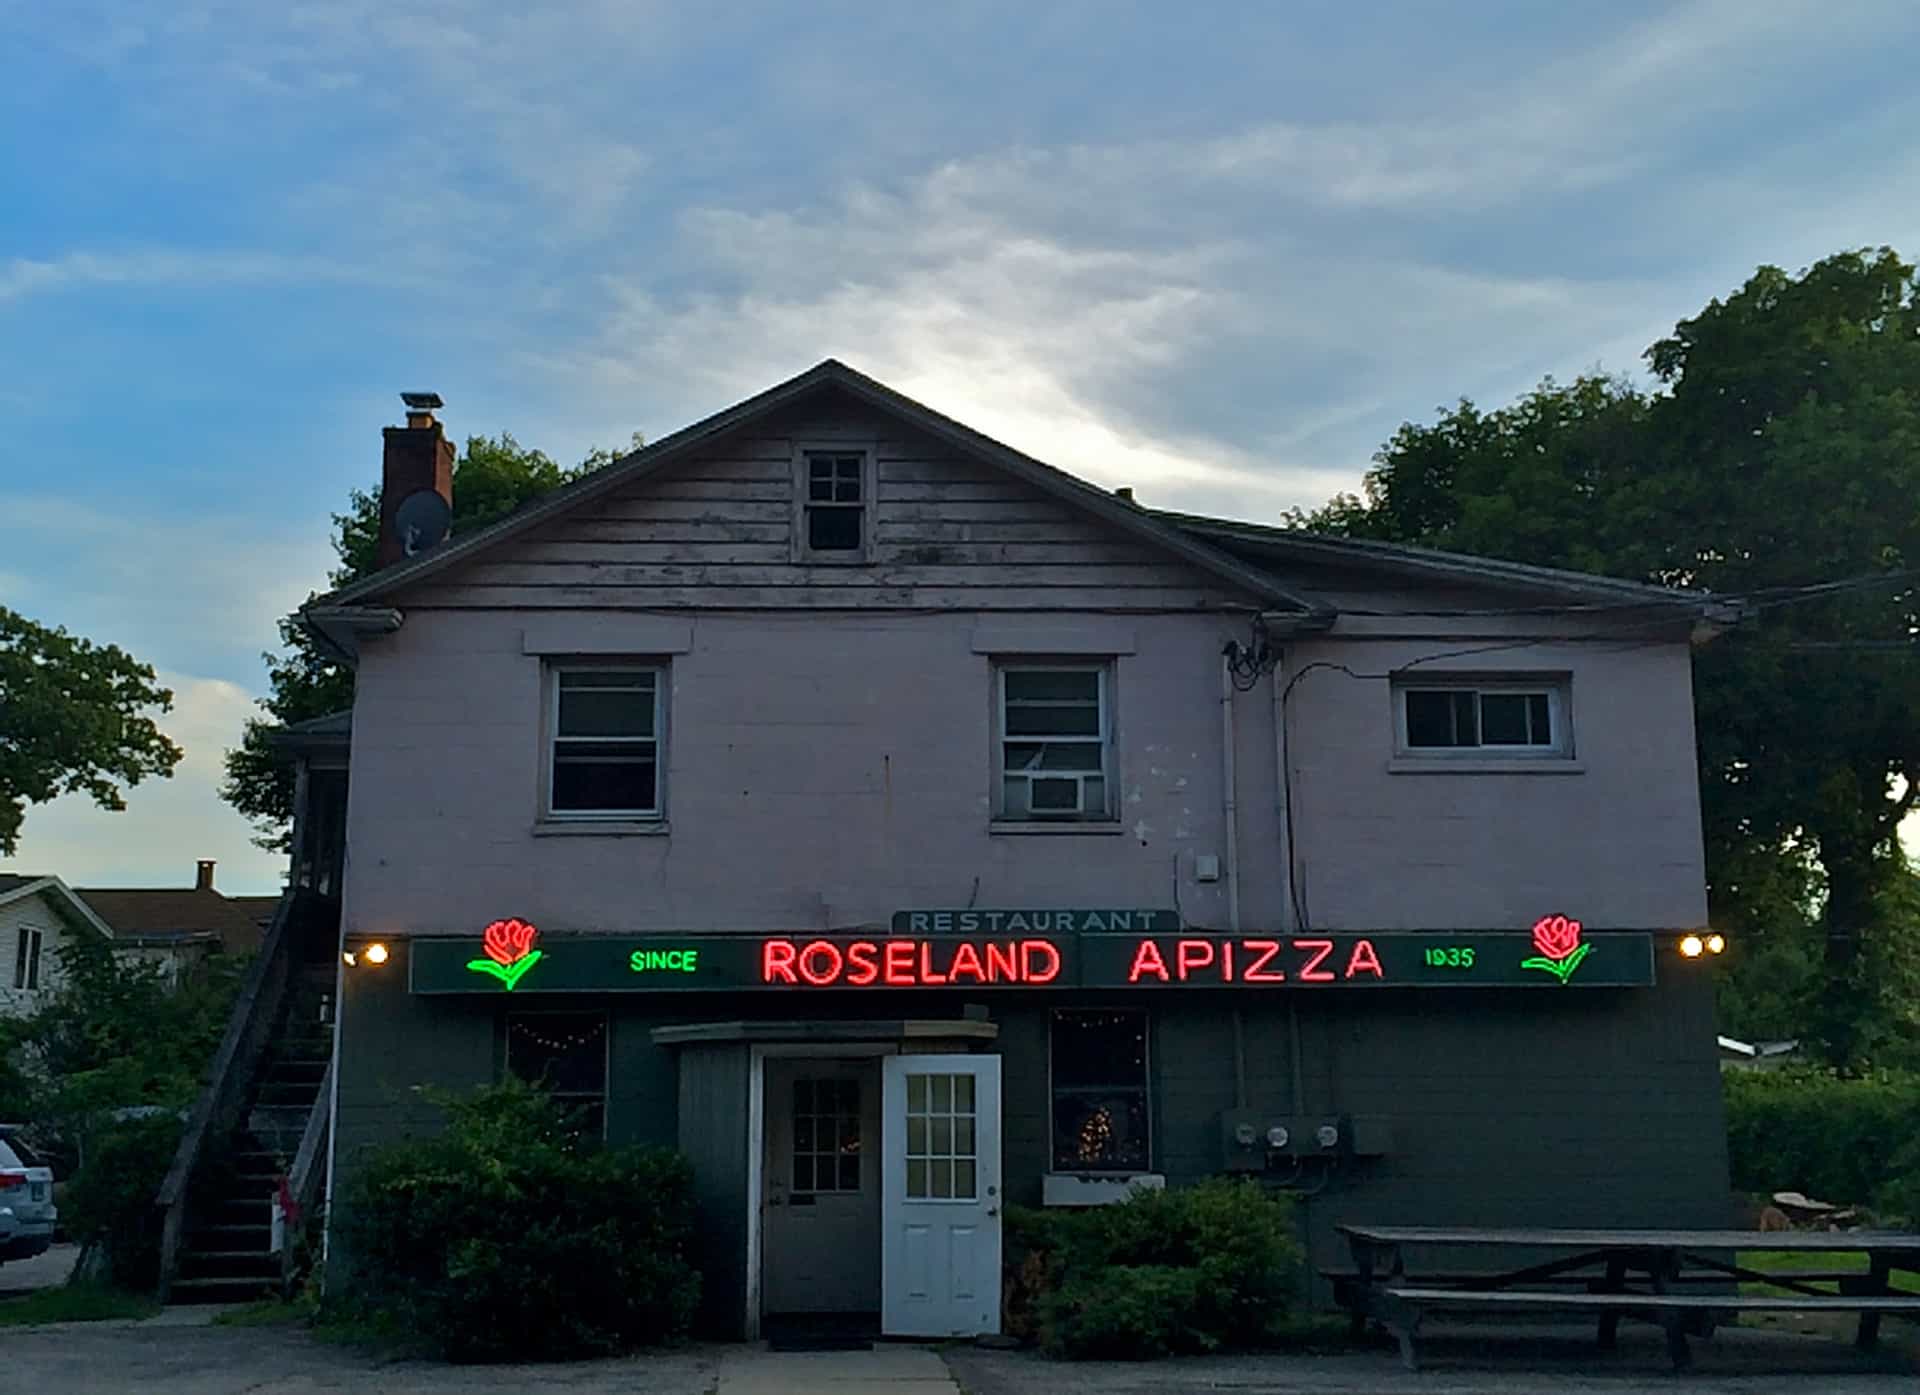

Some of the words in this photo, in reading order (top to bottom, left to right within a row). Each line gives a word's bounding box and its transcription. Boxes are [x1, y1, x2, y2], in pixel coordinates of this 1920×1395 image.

[909, 911, 1157, 932] RESTAURANT
[629, 950, 698, 973] SINCE
[762, 940, 1060, 986] ROSELAND
[1128, 939, 1385, 983] APIZZA
[1424, 947, 1476, 968] 1935
